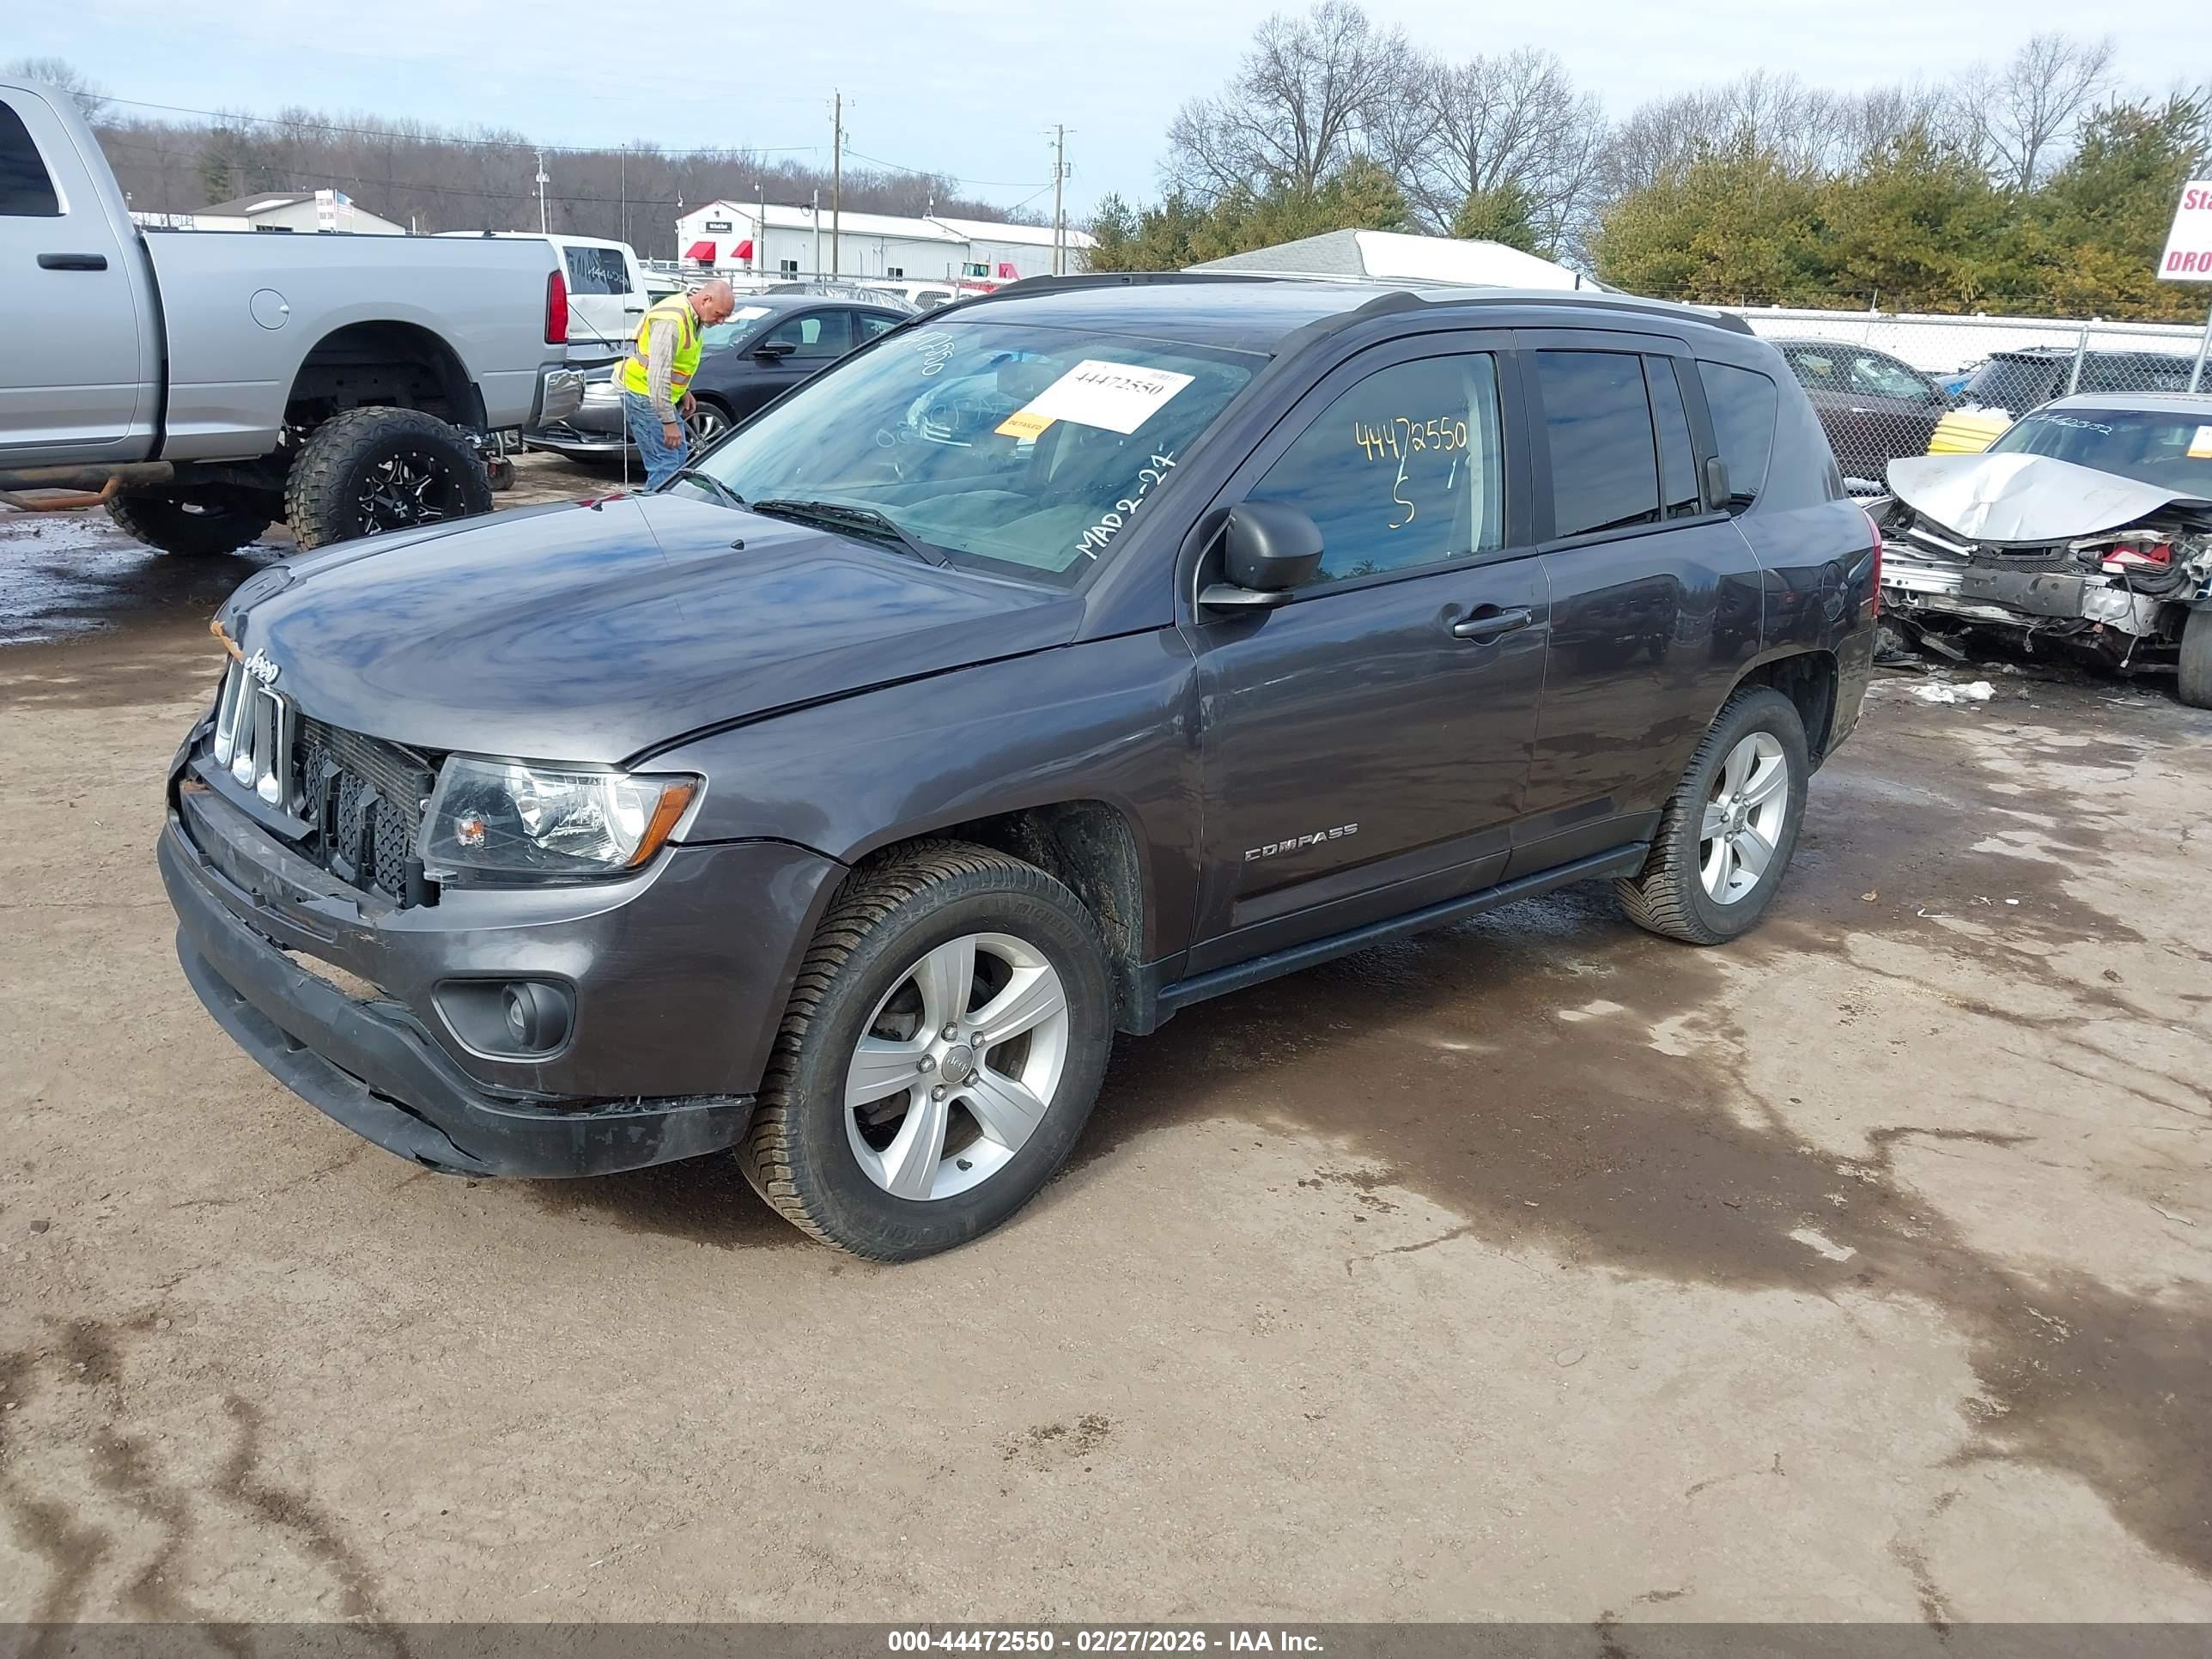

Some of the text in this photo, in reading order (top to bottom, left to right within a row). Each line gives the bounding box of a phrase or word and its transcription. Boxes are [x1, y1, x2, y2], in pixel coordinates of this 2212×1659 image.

[1075, 371, 1164, 396] 44472550
[1007, 419, 1042, 431] DETAILED
[1355, 416, 1467, 460] 44472550
[244, 647, 279, 684] Jeep
[1244, 823, 1358, 862] COMPASS
